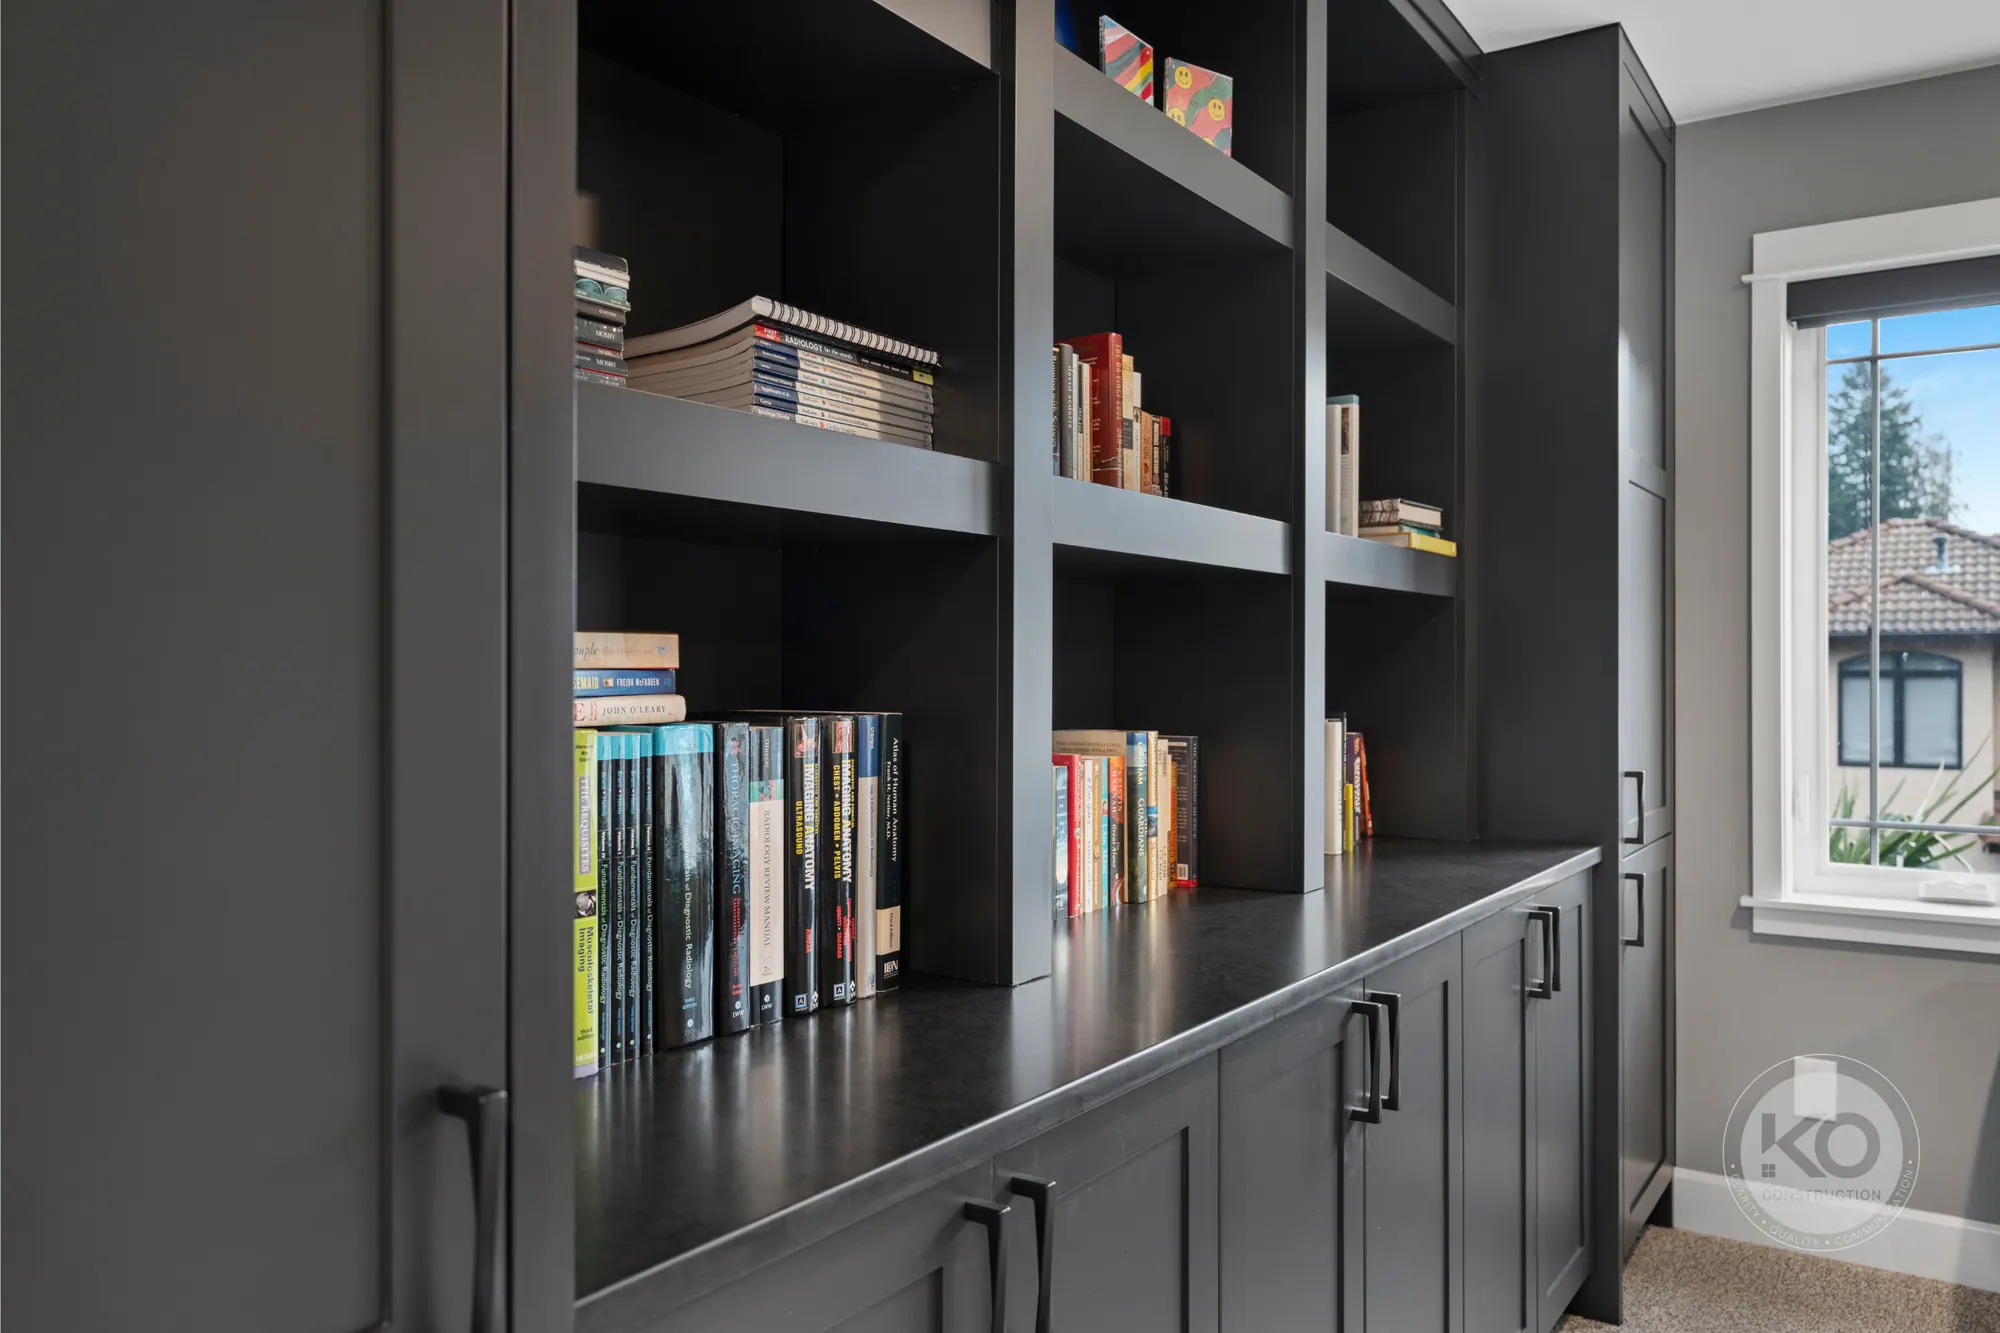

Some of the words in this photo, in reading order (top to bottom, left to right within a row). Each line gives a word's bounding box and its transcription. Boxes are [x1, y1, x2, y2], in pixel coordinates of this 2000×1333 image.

[595, 329, 616, 341] MOSBY
[785, 334, 823, 352] RADIOLOGY
[596, 359, 617, 369] MOSBY
[1115, 362, 1122, 373] DA
[617, 677, 635, 687] FREIDA
[635, 677, 660, 687] McFADDEN
[602, 707, 627, 716] JOHN
[630, 705, 666, 714] O'LEARY
[833, 764, 841, 791] CHEST
[842, 759, 852, 817] IMAGING
[887, 783, 891, 792] H.
[893, 764, 899, 775] of
[580, 779, 590, 801] THE
[731, 762, 740, 825] THORACIC
[804, 763, 815, 823] IMAGING
[580, 805, 590, 873] REQUISITES
[795, 800, 803, 855] ULTRASOUND
[833, 801, 841, 841] ABDOMEN
[732, 834, 741, 895] IMAGING
[804, 825, 815, 891] ANATOMY
[833, 850, 841, 880] PELVIS
[842, 819, 852, 883] ANATOMY
[685, 883, 691, 891] of
[645, 914, 653, 954] Diagnostic
[683, 892, 692, 941] Diagnostic
[577, 927, 586, 973] Imaging
[600, 924, 608, 964] Diagnostic
[615, 921, 624, 960] Diagnostic
[629, 918, 637, 958] Diagnostic
[586, 926, 594, 1015] Musculoskeletal
[599, 966, 608, 1004] Radiology
[615, 962, 624, 1000] Radiology
[629, 960, 637, 998] Radiology
[645, 956, 653, 993] Radiology
[684, 943, 693, 989] Radiology
